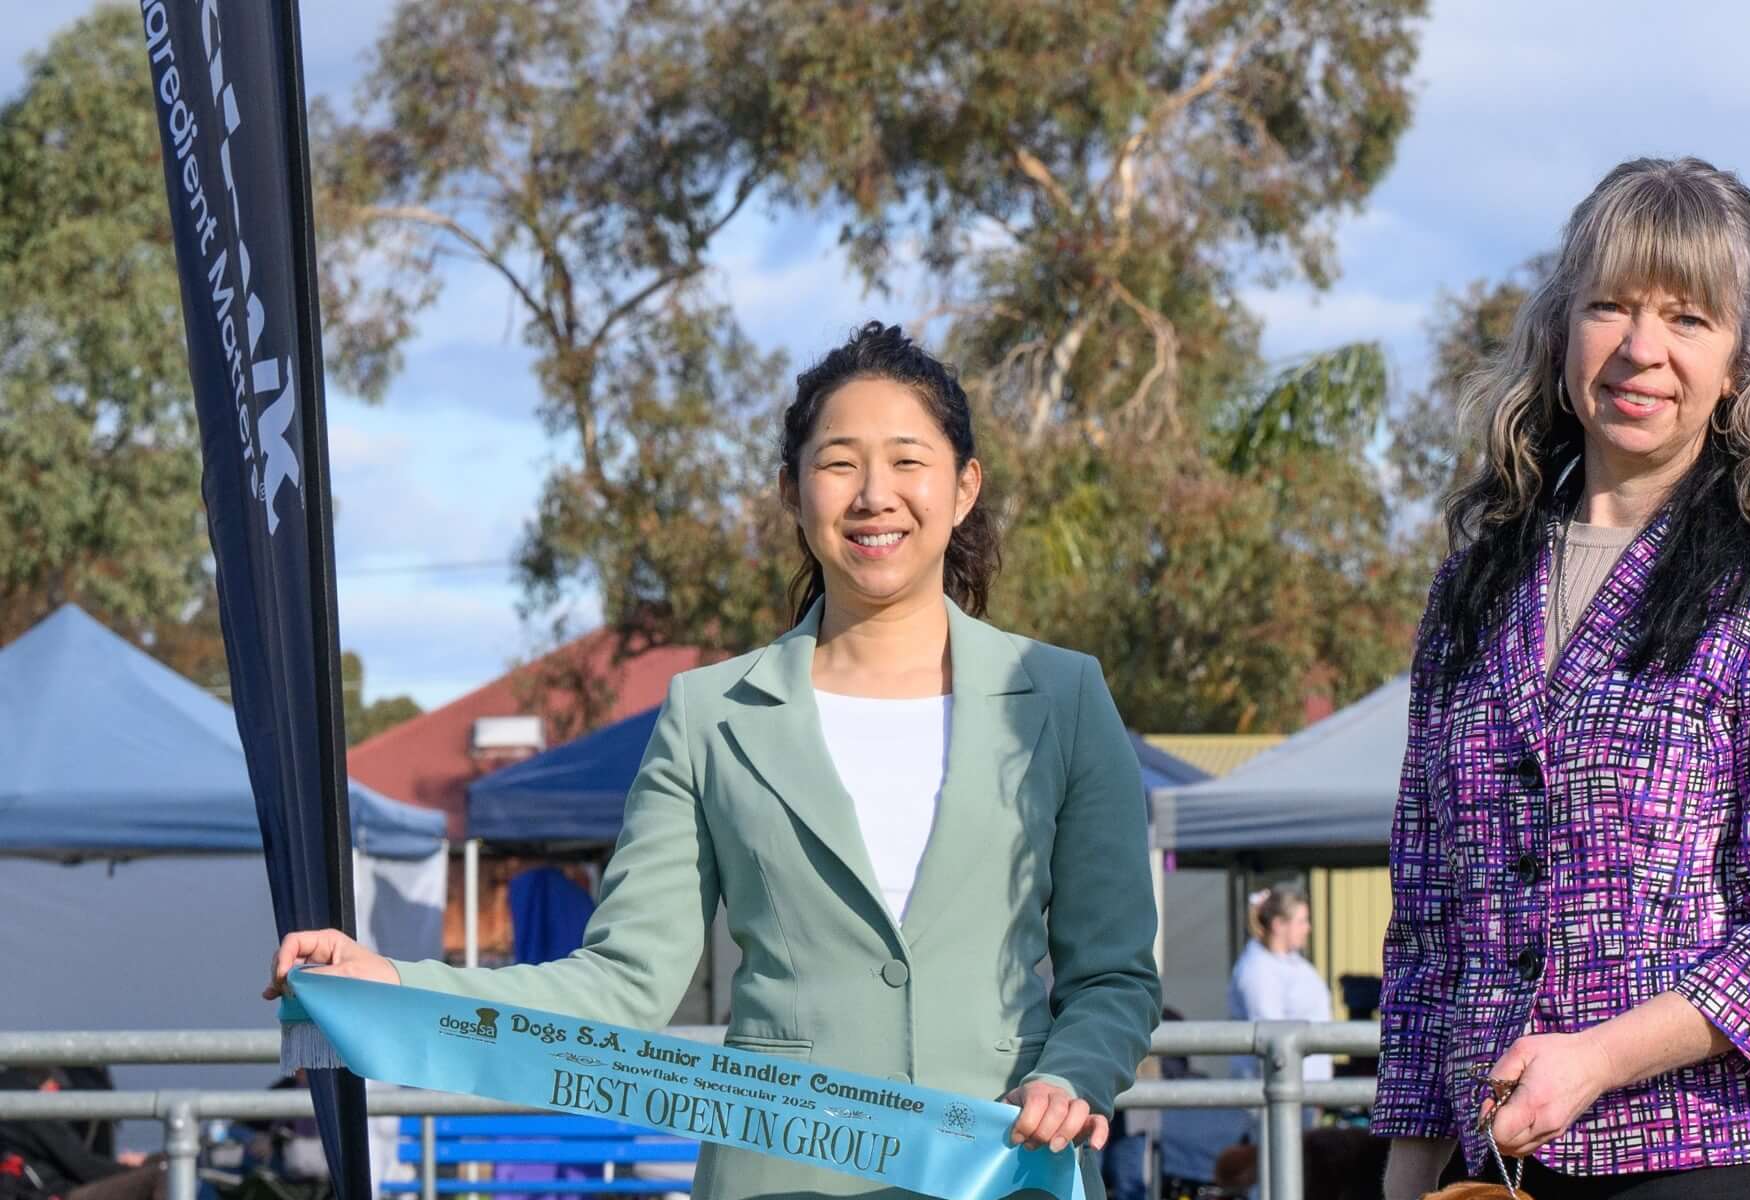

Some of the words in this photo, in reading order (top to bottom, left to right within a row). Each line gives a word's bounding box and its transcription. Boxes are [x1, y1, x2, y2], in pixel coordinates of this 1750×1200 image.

[511, 1014, 567, 1044] Dogs
[576, 1026, 626, 1053] S.A.
[636, 1040, 702, 1068] Junior
[711, 1054, 803, 1087] Handler
[810, 1073, 925, 1114] Committee
[612, 1061, 688, 1085] Snowflake
[693, 1077, 777, 1103] Spectacular
[782, 1095, 817, 1110] 2025
[550, 1068, 638, 1117] BEST
[645, 1087, 735, 1138] OPEN
[739, 1105, 780, 1149] IN
[782, 1116, 902, 1175] GROUP
